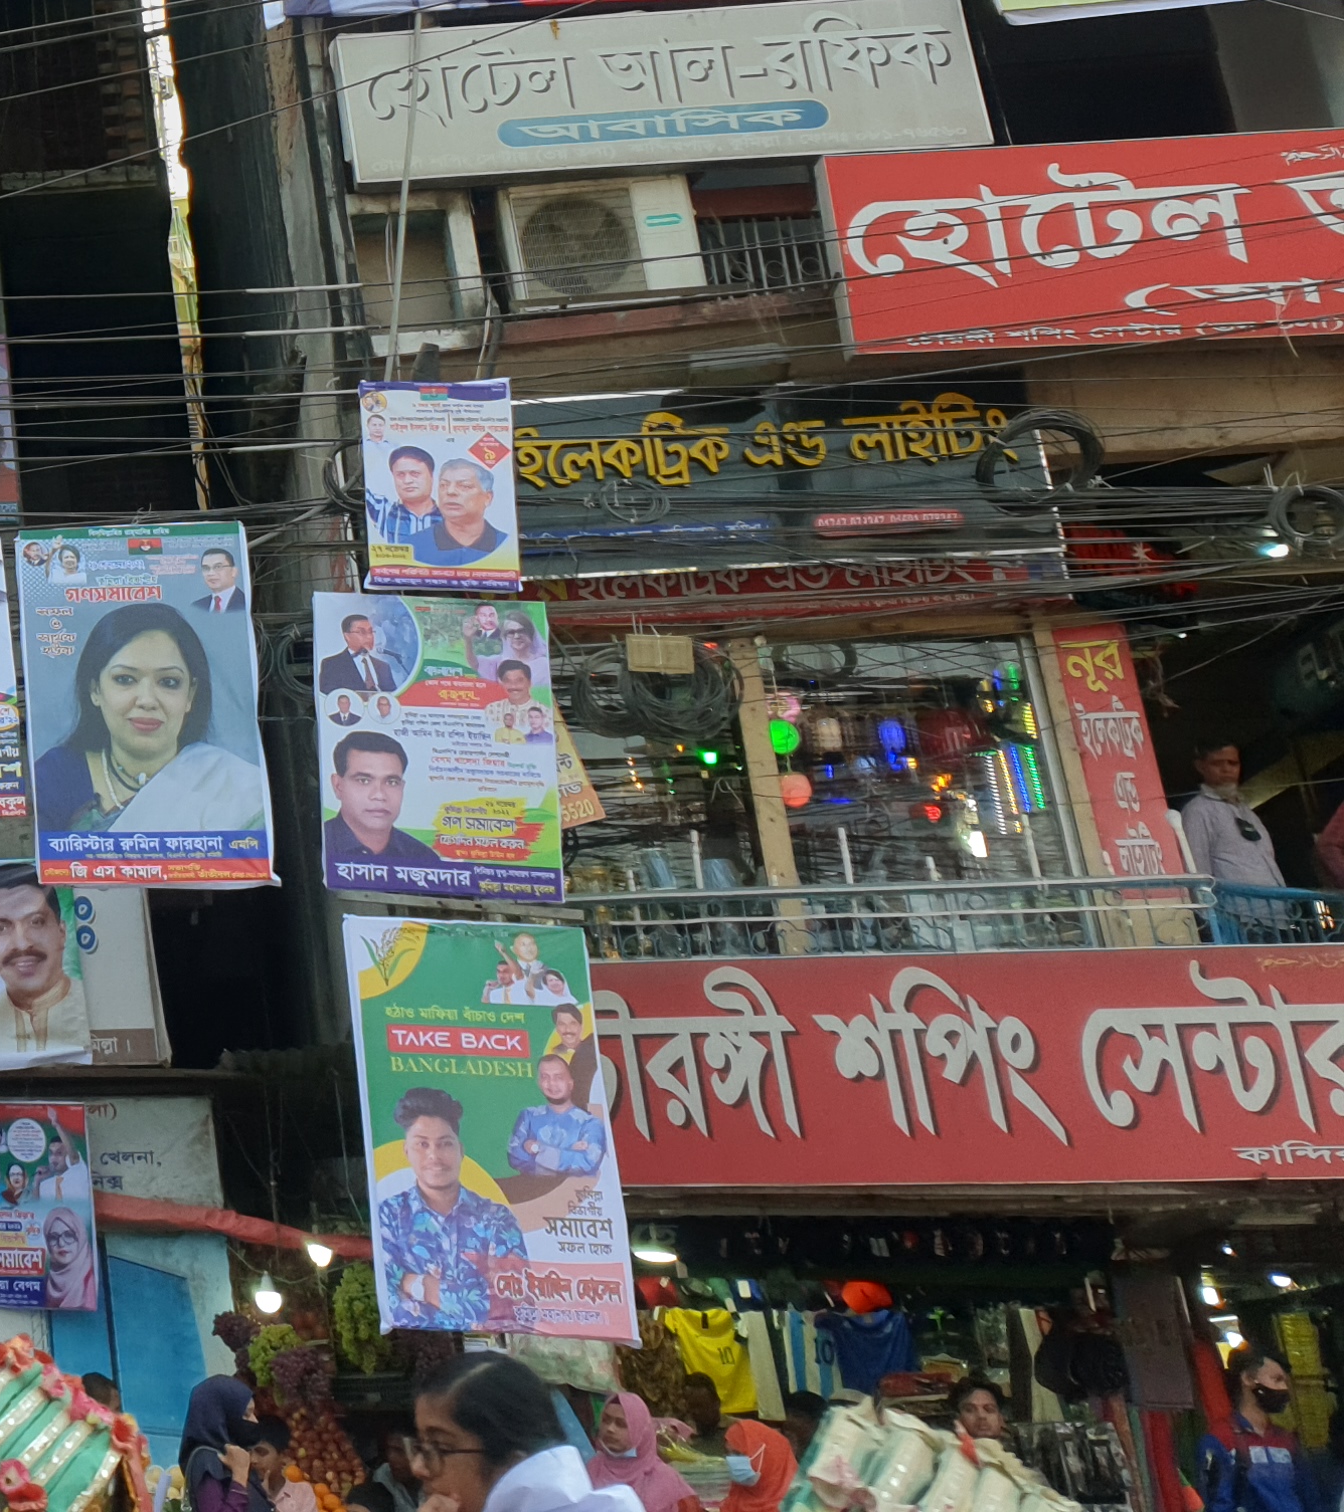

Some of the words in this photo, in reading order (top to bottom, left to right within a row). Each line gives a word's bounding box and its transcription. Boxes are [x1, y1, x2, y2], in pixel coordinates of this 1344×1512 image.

[364, 31, 577, 128] হোটেল
[596, 15, 956, 110] আল-রফিক
[516, 106, 808, 143] আবাসিক
[846, 162, 1253, 288] হোটেল
[118, 834, 160, 853] রুমিন
[164, 834, 224, 852] ফারহানা
[337, 861, 389, 883] হাসান
[395, 866, 471, 889] মজুমদার
[392, 1029, 452, 1048] TAKE
[461, 1032, 523, 1052] BACK
[812, 964, 1069, 1148] শপিং
[390, 1055, 533, 1079] BANGLADESH
